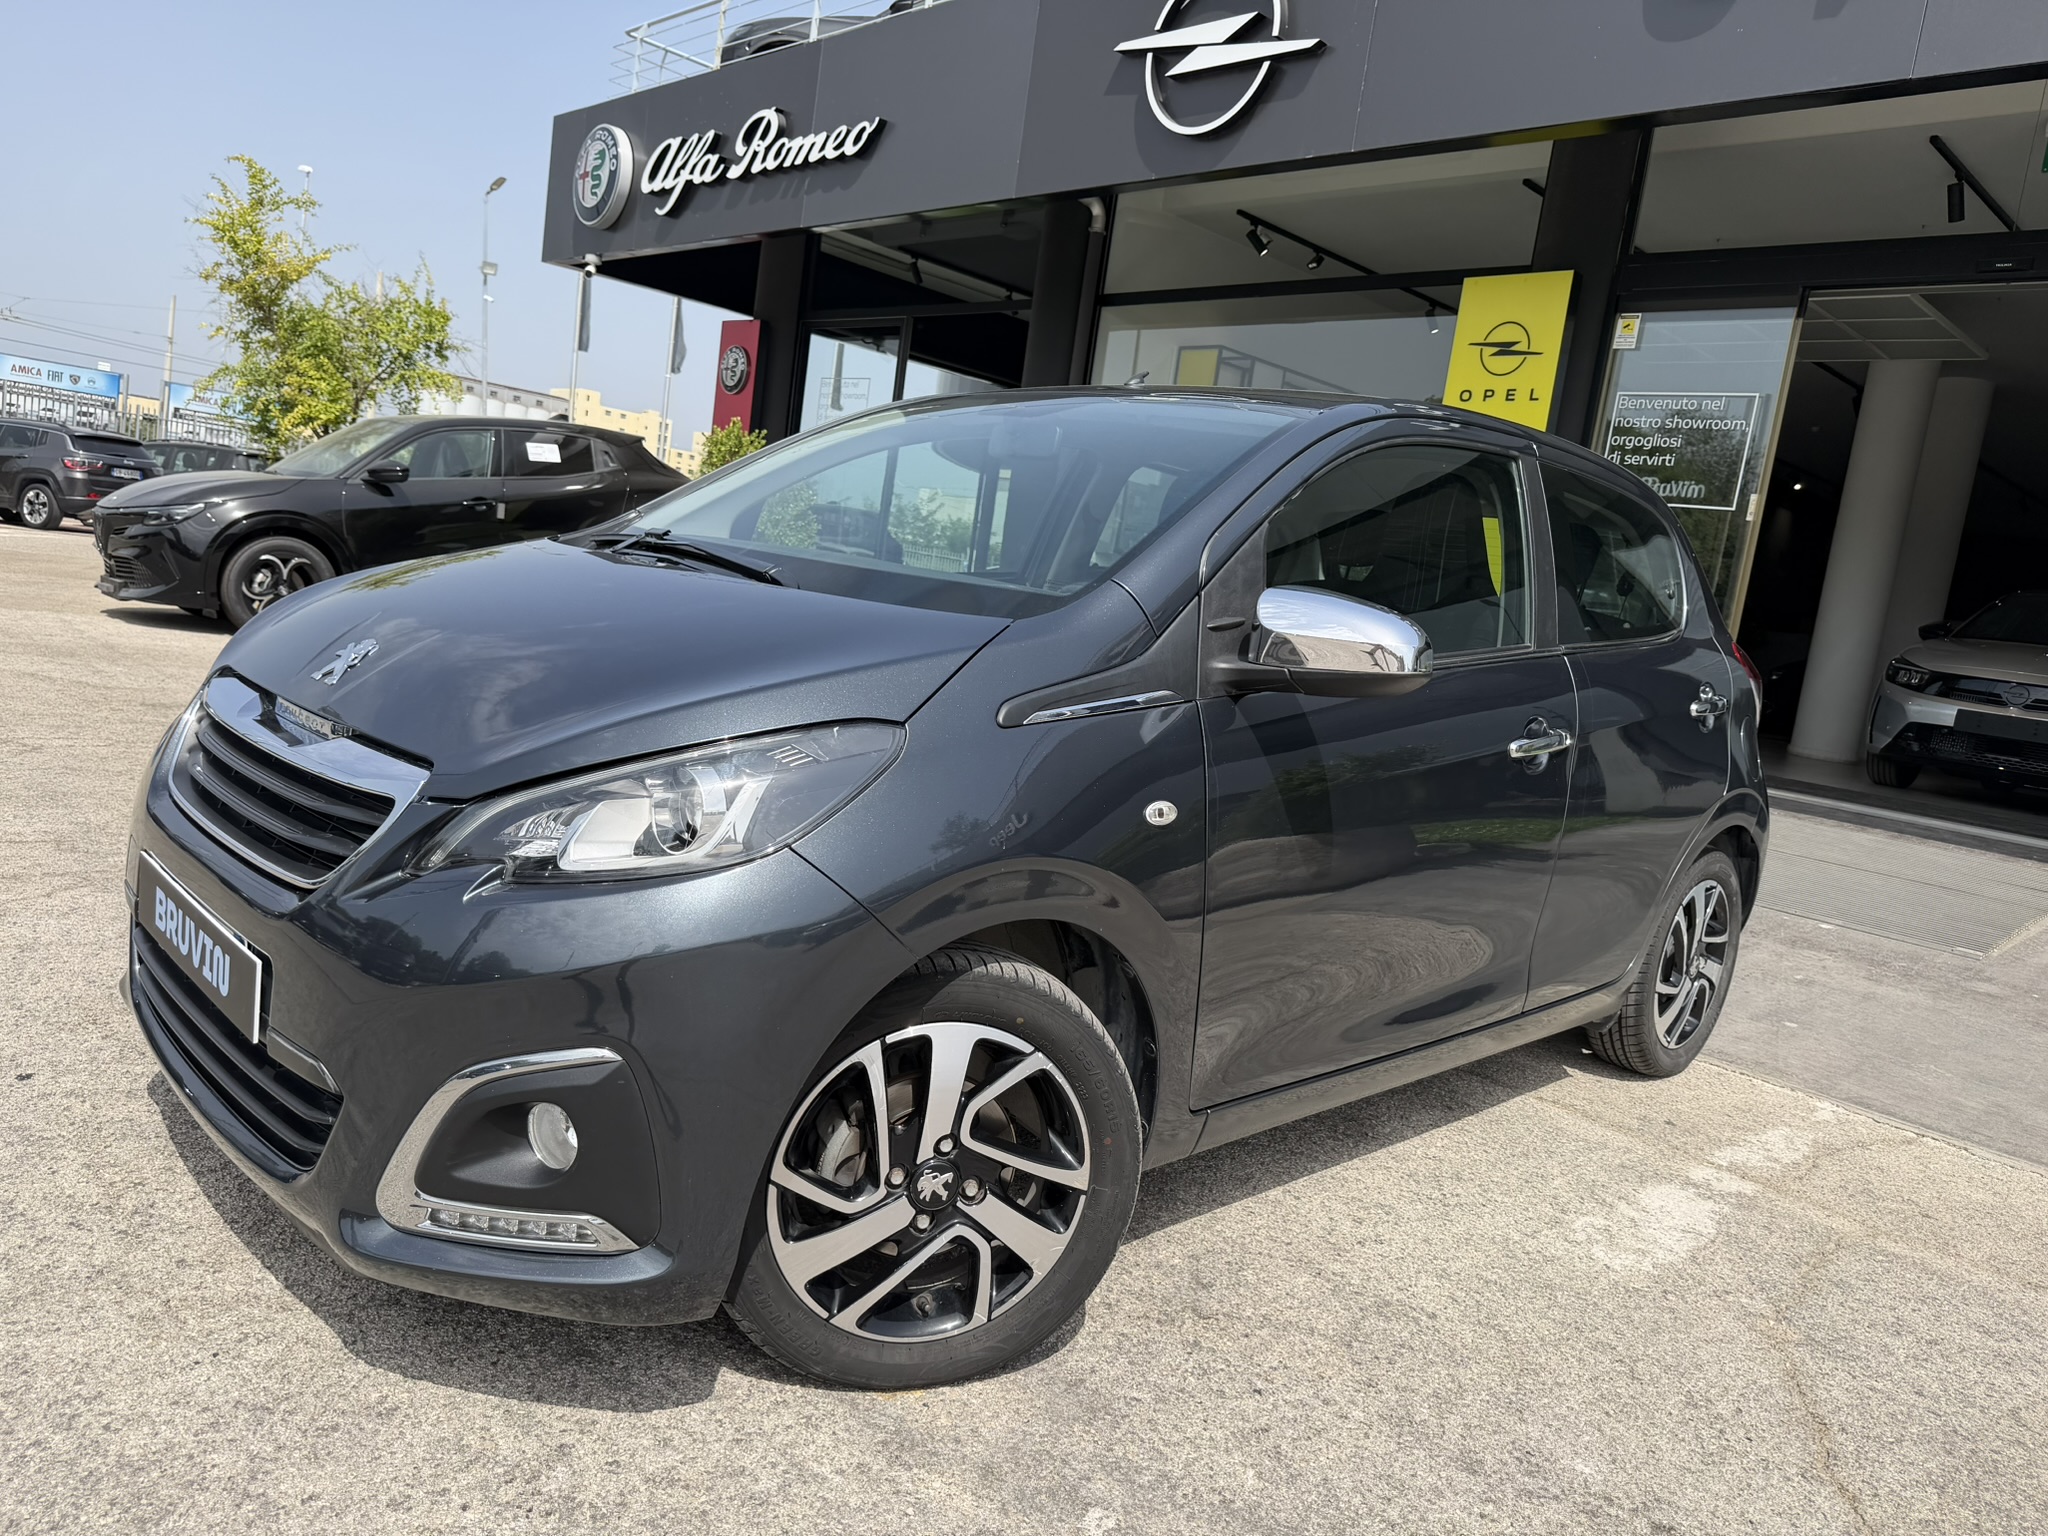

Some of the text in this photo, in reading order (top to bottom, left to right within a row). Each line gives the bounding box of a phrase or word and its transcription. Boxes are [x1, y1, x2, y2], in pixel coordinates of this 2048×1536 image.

[641, 129, 725, 216] Alfa
[726, 106, 881, 180] Romeo
[10, 364, 64, 383] AMICA FIAT
[1459, 388, 1540, 402] OPEL
[1618, 396, 1726, 411] Benvenuto nel
[1614, 415, 1749, 433] nostro showroom,
[1610, 433, 1683, 450] orgogliosi
[1607, 451, 1676, 467] di servirti
[155, 886, 230, 997] BRUVIN
